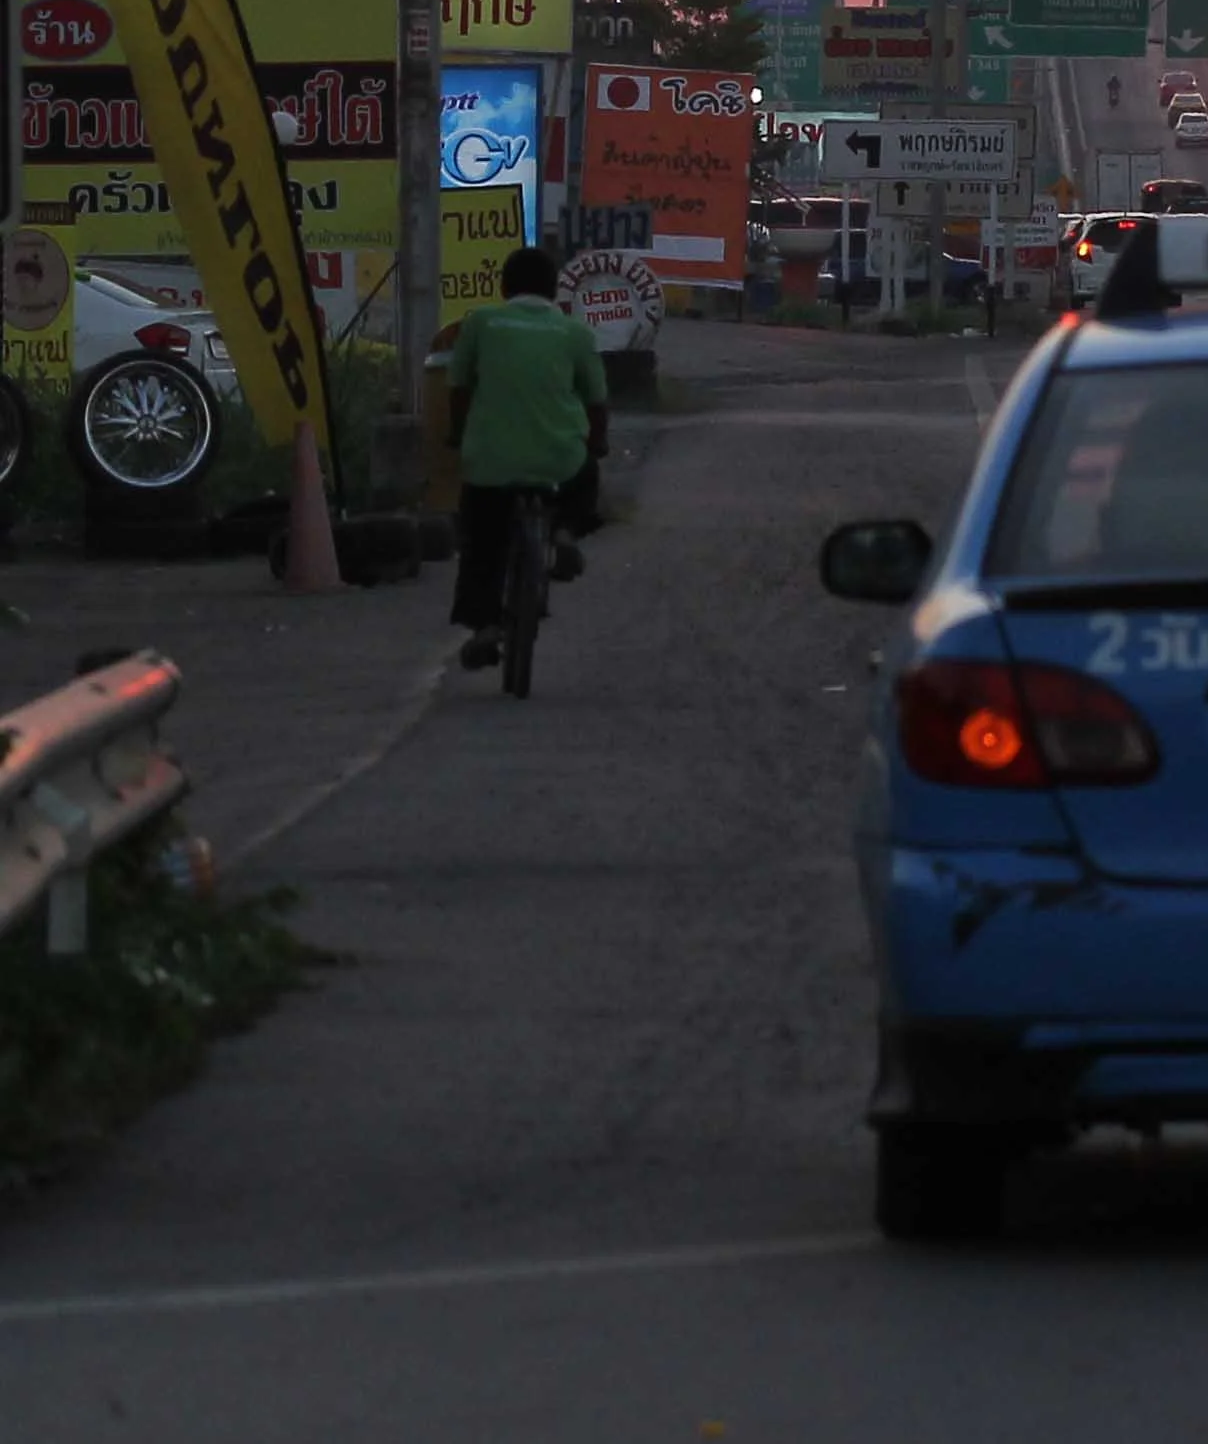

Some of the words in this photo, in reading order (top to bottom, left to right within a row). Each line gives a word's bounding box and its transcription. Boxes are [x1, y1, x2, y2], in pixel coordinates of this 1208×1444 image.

[26, 9, 96, 46] ร้าน
[442, 193, 521, 241] าแฟ
[1085, 610, 1128, 675] 2
